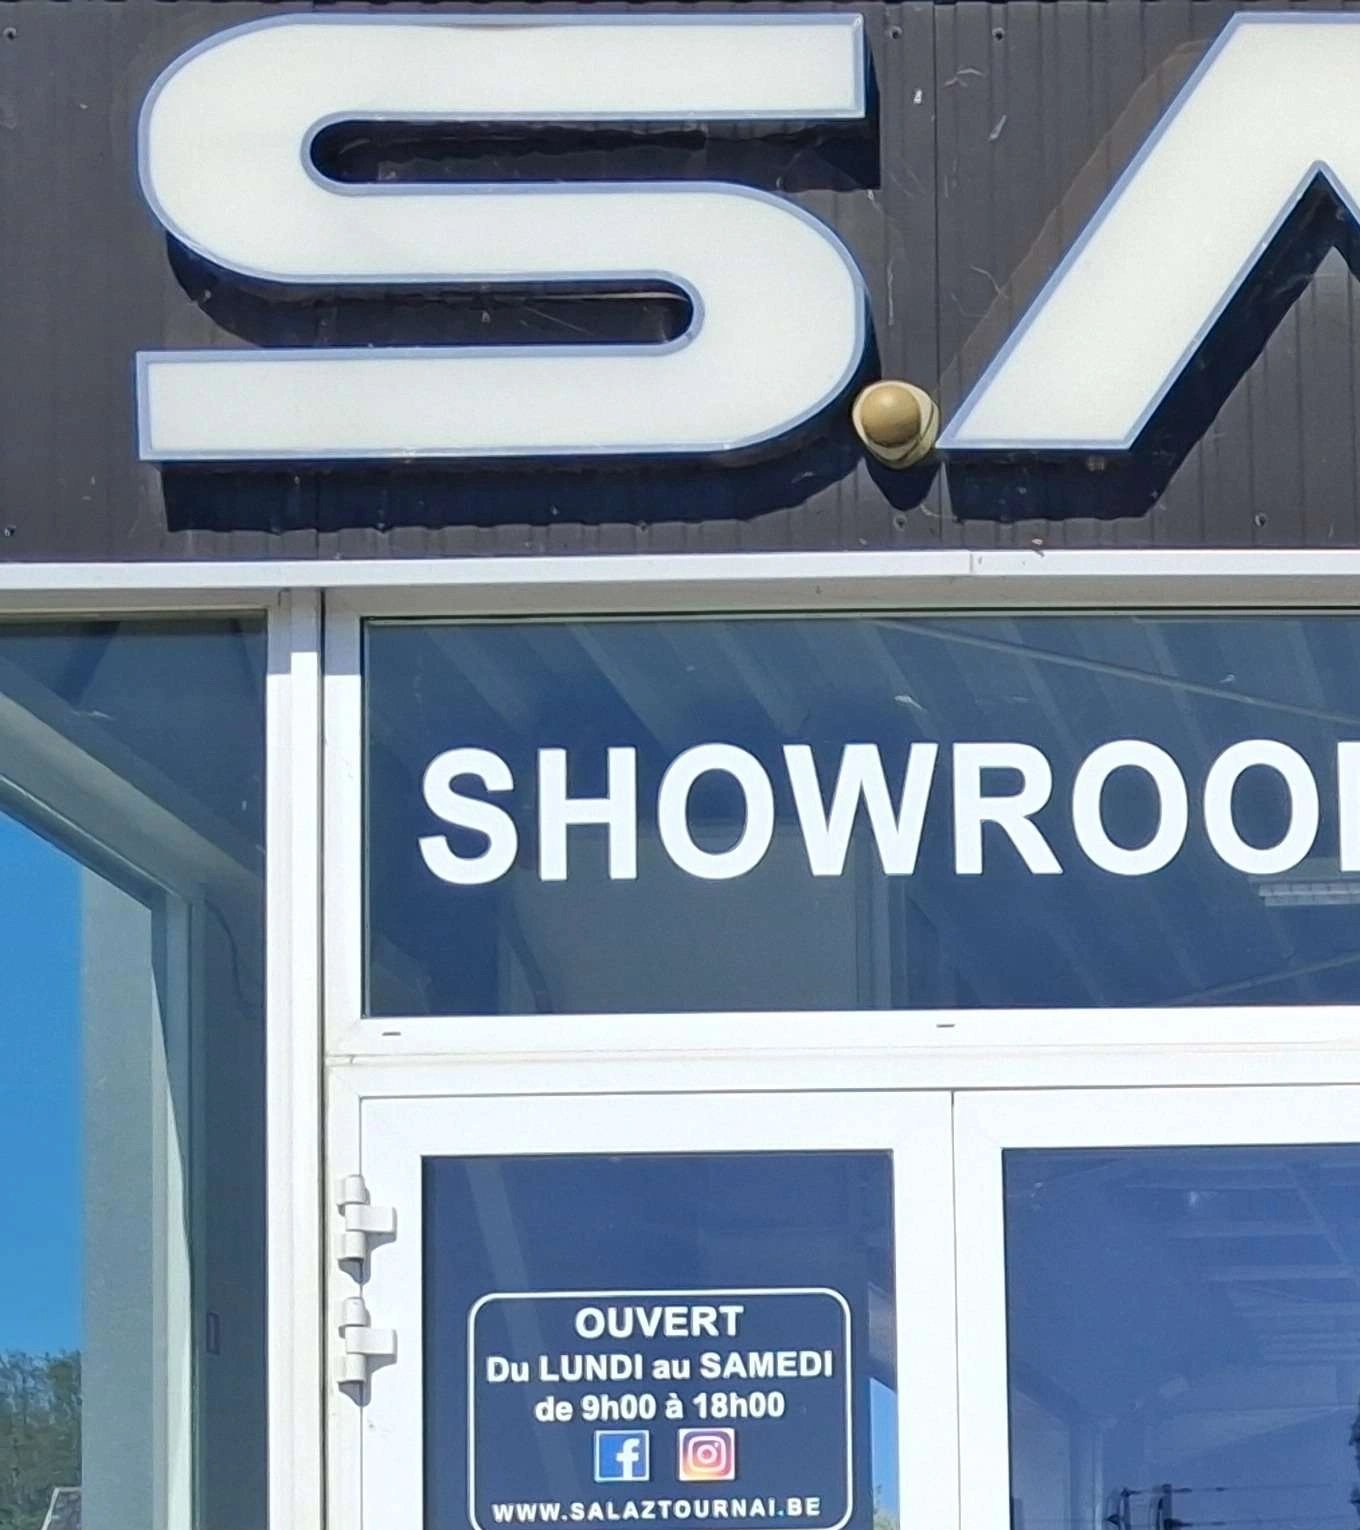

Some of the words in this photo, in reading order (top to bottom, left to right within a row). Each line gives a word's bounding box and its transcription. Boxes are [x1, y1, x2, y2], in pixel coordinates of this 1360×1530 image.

[575, 1305, 744, 1338] OUVERT
[486, 1357, 529, 1383] Du
[539, 1353, 643, 1382] LUNDI
[652, 1357, 691, 1380] au
[699, 1350, 833, 1379] SAMEDI
[534, 1395, 573, 1422] de
[582, 1393, 657, 1421] 9h00
[665, 1391, 684, 1420] à
[692, 1391, 786, 1419] 18h00
[492, 1497, 821, 1522] WWW.SALAZTOURNAI.BE
